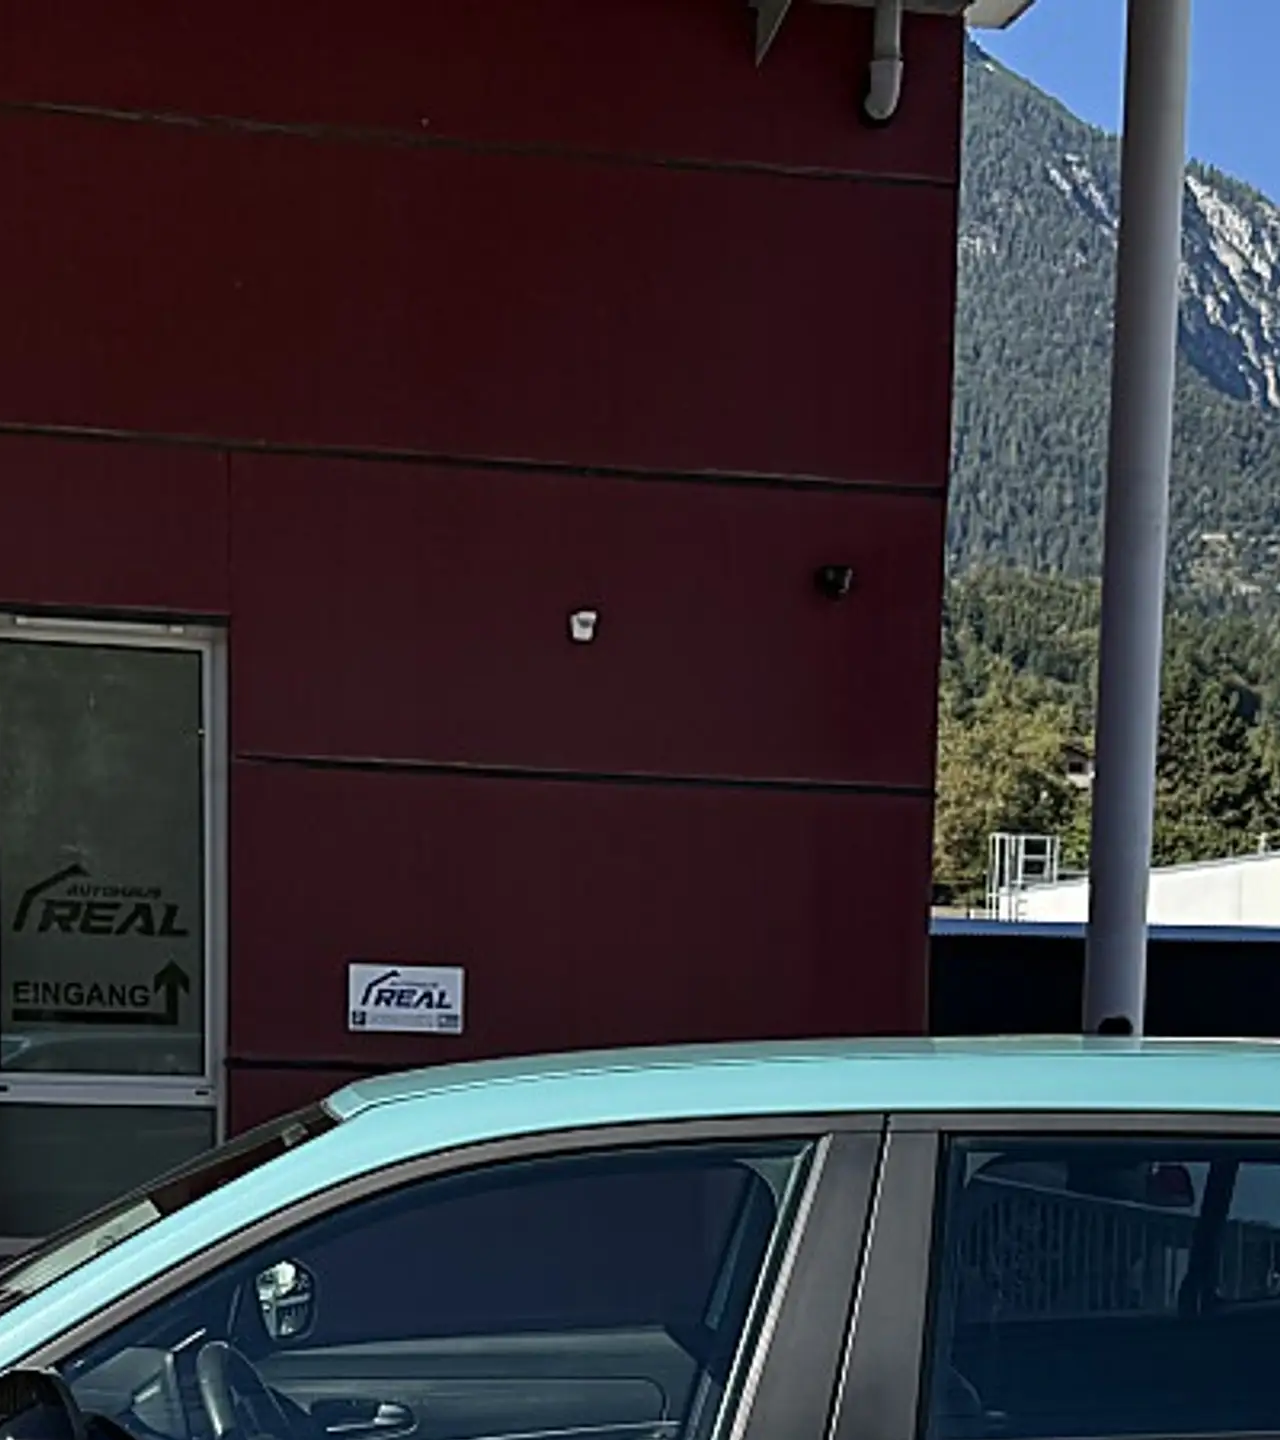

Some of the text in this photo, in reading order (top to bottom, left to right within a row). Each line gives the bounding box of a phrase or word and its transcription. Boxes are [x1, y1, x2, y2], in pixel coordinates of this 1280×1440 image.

[38, 899, 190, 938] REAL
[13, 980, 151, 1007] EINGANG
[373, 988, 453, 1010] REAL
